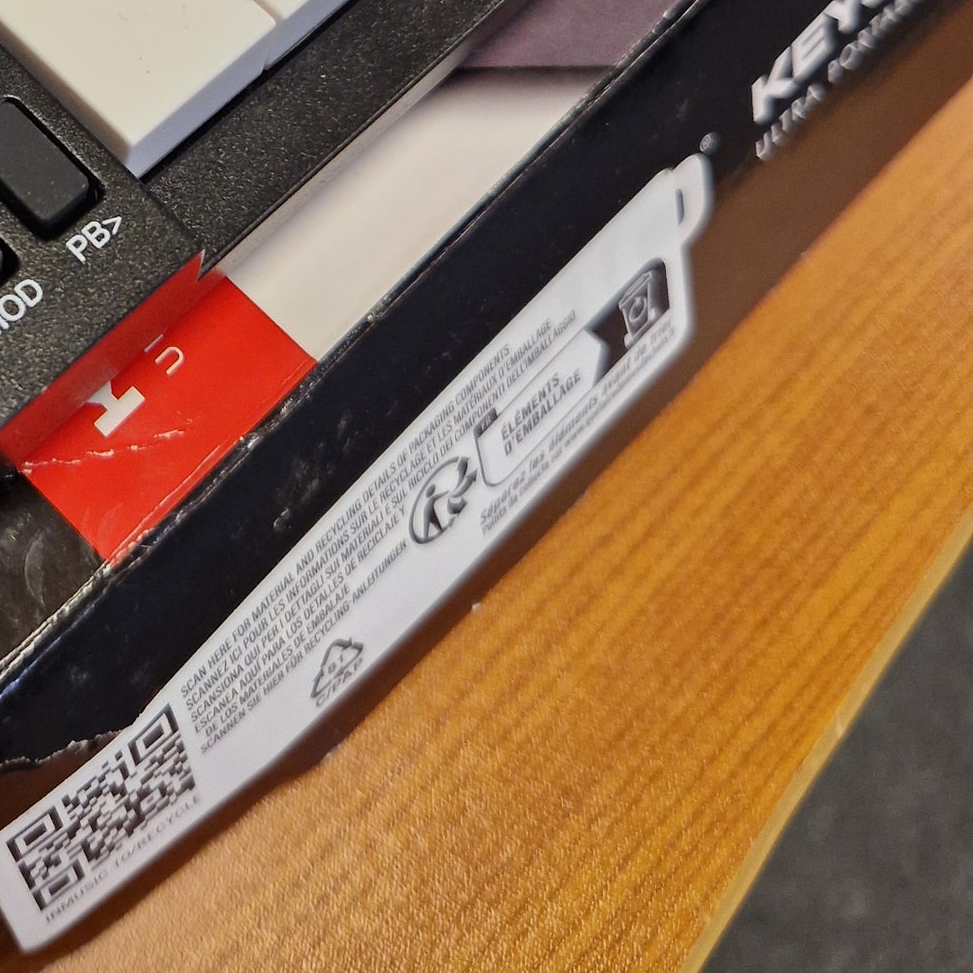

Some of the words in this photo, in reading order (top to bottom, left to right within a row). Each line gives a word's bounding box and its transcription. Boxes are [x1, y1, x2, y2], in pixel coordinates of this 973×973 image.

[498, 371, 561, 441] ÉLÉMENTS
[502, 366, 583, 456] D'EMBALLAGE
[180, 664, 207, 698] SCAN
[206, 637, 232, 668] HERE
[231, 616, 251, 641] FOR
[250, 571, 294, 621] MATERIAL
[294, 548, 315, 575] AND
[314, 498, 362, 553] RECYCLING
[361, 461, 397, 503] DETAILS
[395, 447, 409, 467] OF
[407, 400, 454, 454] PACKAGING
[454, 343, 509, 405] COMPONENTS
[185, 658, 229, 711] SCANNEZ
[228, 645, 243, 664] ICI
[242, 615, 269, 650] POUR
[268, 597, 286, 622] LES
[285, 529, 350, 603] INFORMATIONS
[348, 510, 368, 535] SUR
[367, 498, 379, 515] LE
[378, 447, 426, 503] RECYCLAGE
[425, 435, 439, 454] ET
[436, 419, 453, 442] LES
[496, 316, 552, 379] D'EMBALLAGE
[204, 718, 219, 737] DE
[219, 700, 238, 724] LOS
[238, 643, 293, 705] MATERIALES
[292, 629, 306, 648] DE
[305, 582, 350, 635] EMBALAJE
